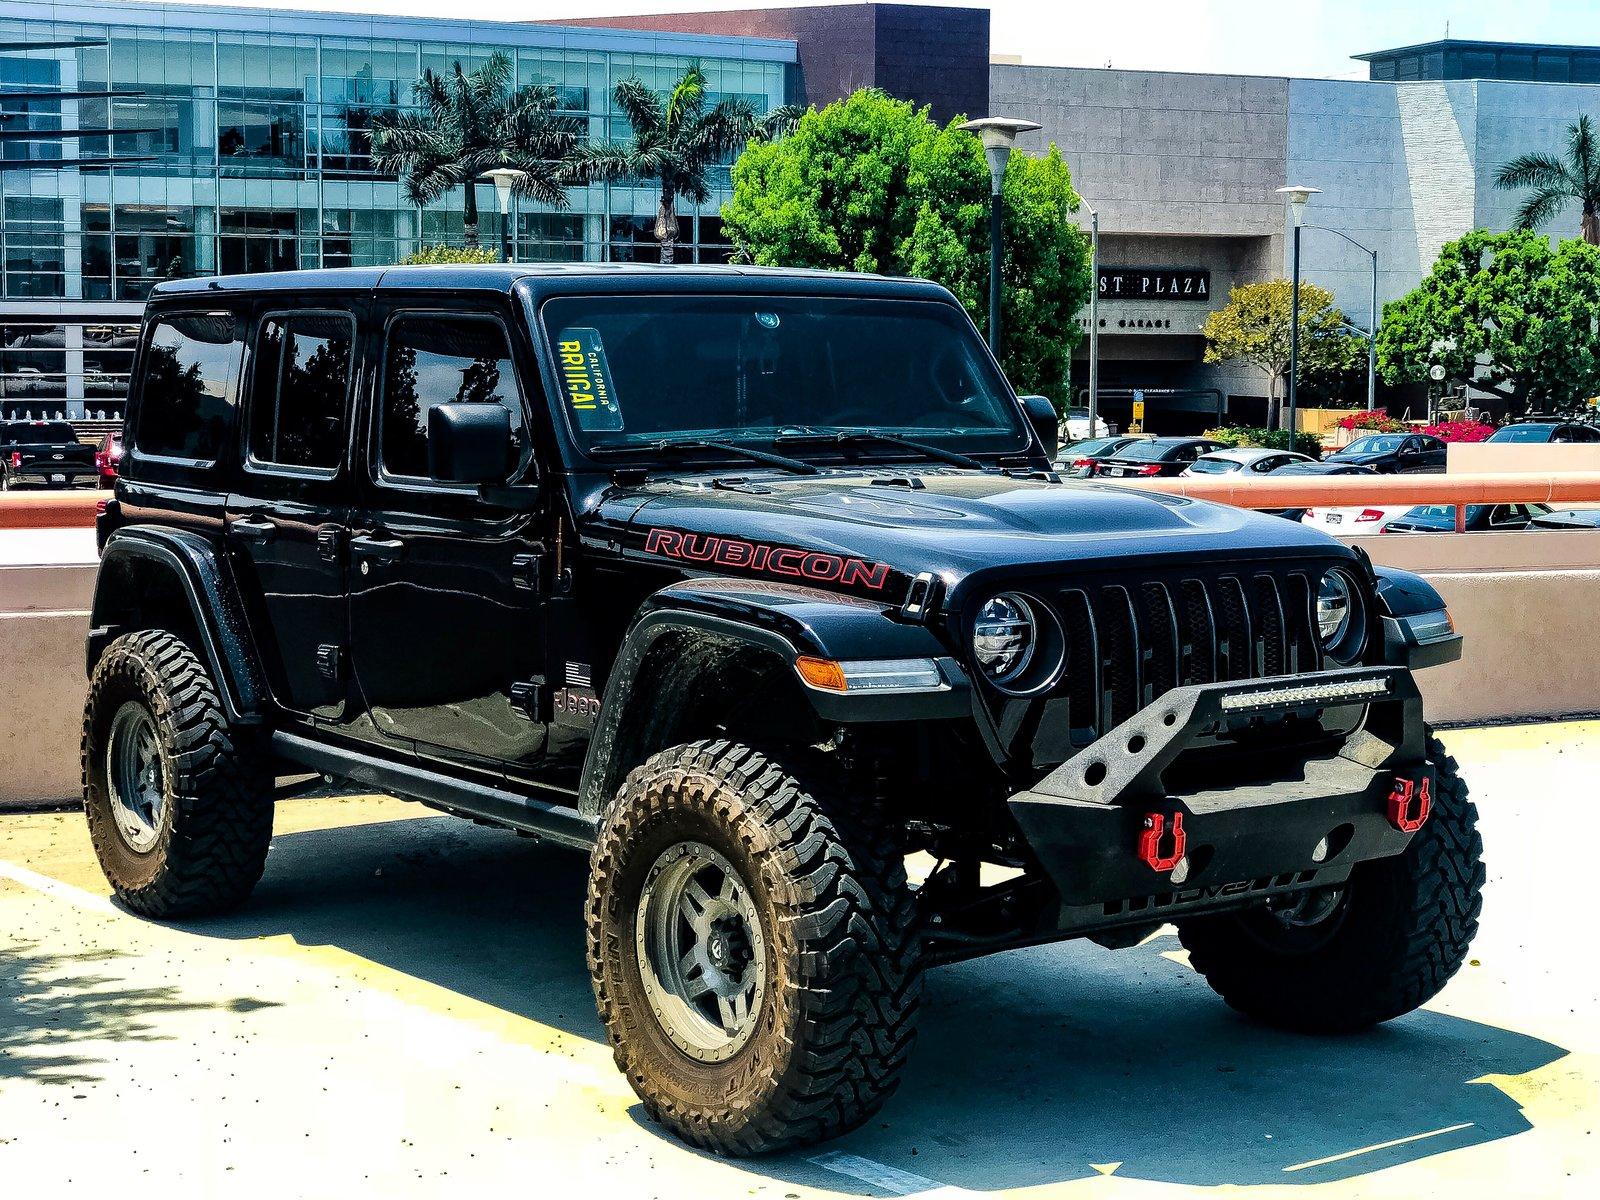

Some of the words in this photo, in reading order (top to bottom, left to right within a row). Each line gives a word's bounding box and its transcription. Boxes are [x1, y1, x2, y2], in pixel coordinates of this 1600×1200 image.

[1099, 276, 1123, 292] ST
[1142, 277, 1207, 294] PLAZA
[1118, 319, 1171, 328] GARAGE
[587, 352, 610, 405] CALIFORNIA
[644, 528, 891, 590] RUBICON
[553, 687, 602, 723] Jeep
